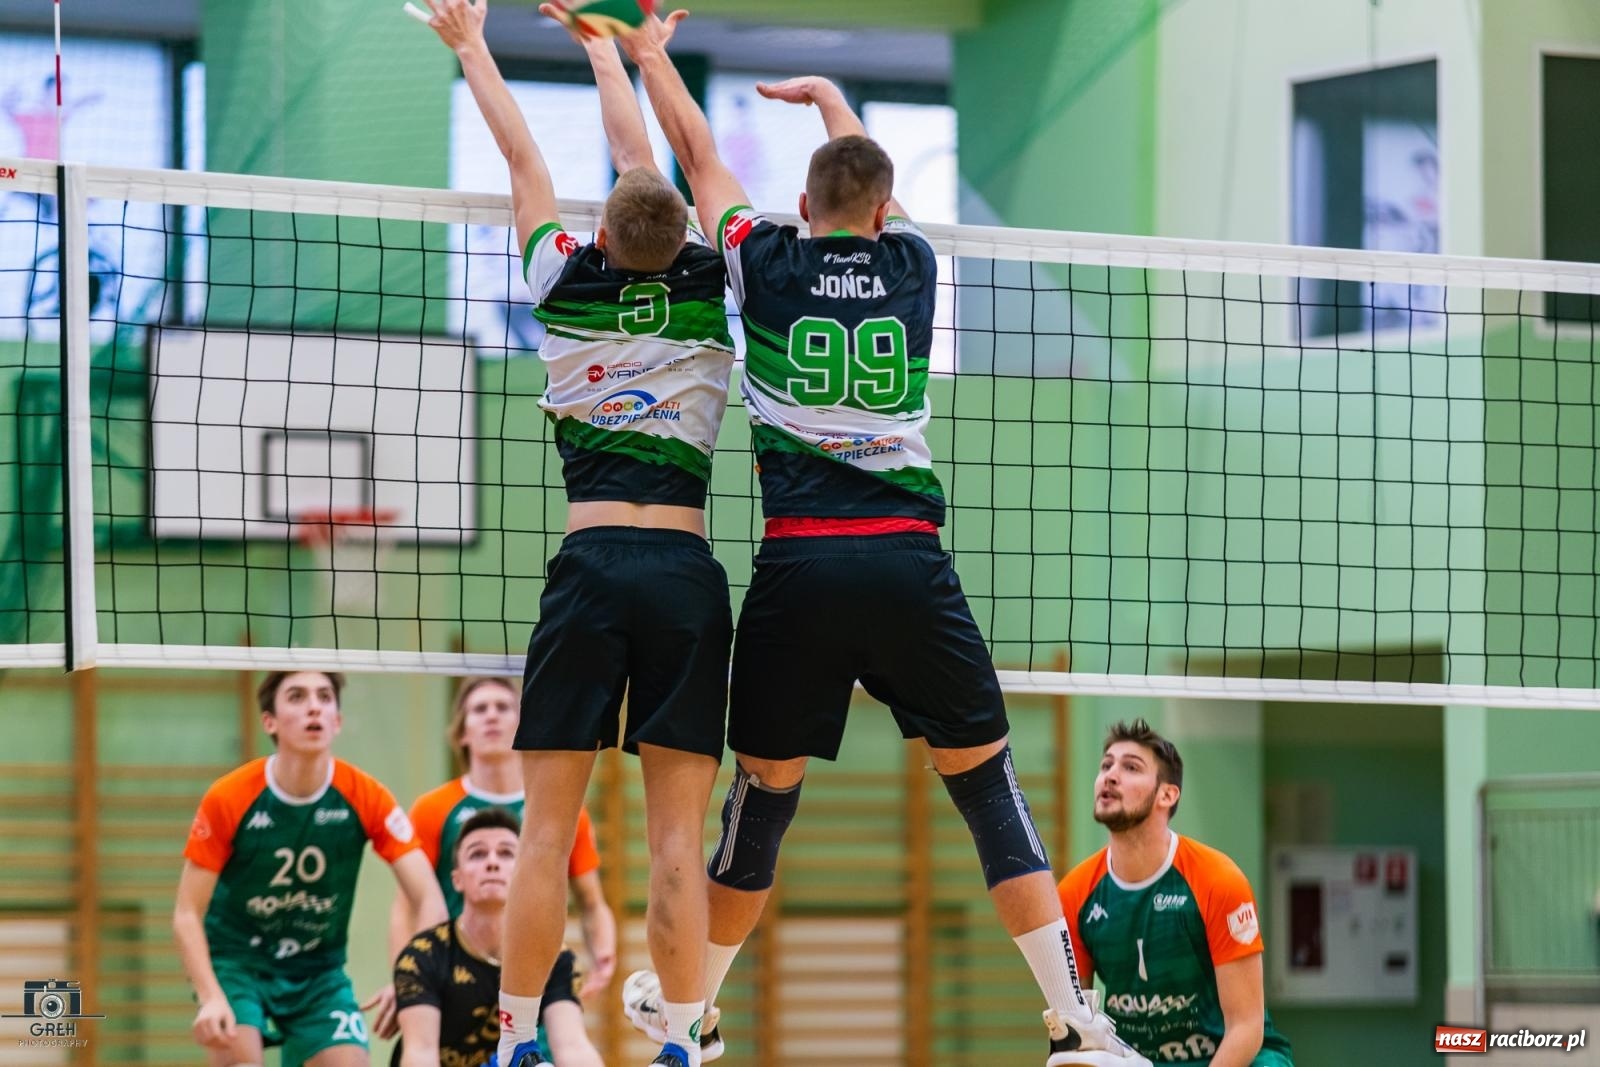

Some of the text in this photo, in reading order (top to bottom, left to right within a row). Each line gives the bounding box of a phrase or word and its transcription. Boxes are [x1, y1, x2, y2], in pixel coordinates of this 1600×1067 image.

[811, 268, 887, 299] JOŃCA
[618, 282, 671, 336] 3
[787, 315, 908, 410] 99
[269, 846, 327, 887] 20
[329, 1010, 369, 1043] 20
